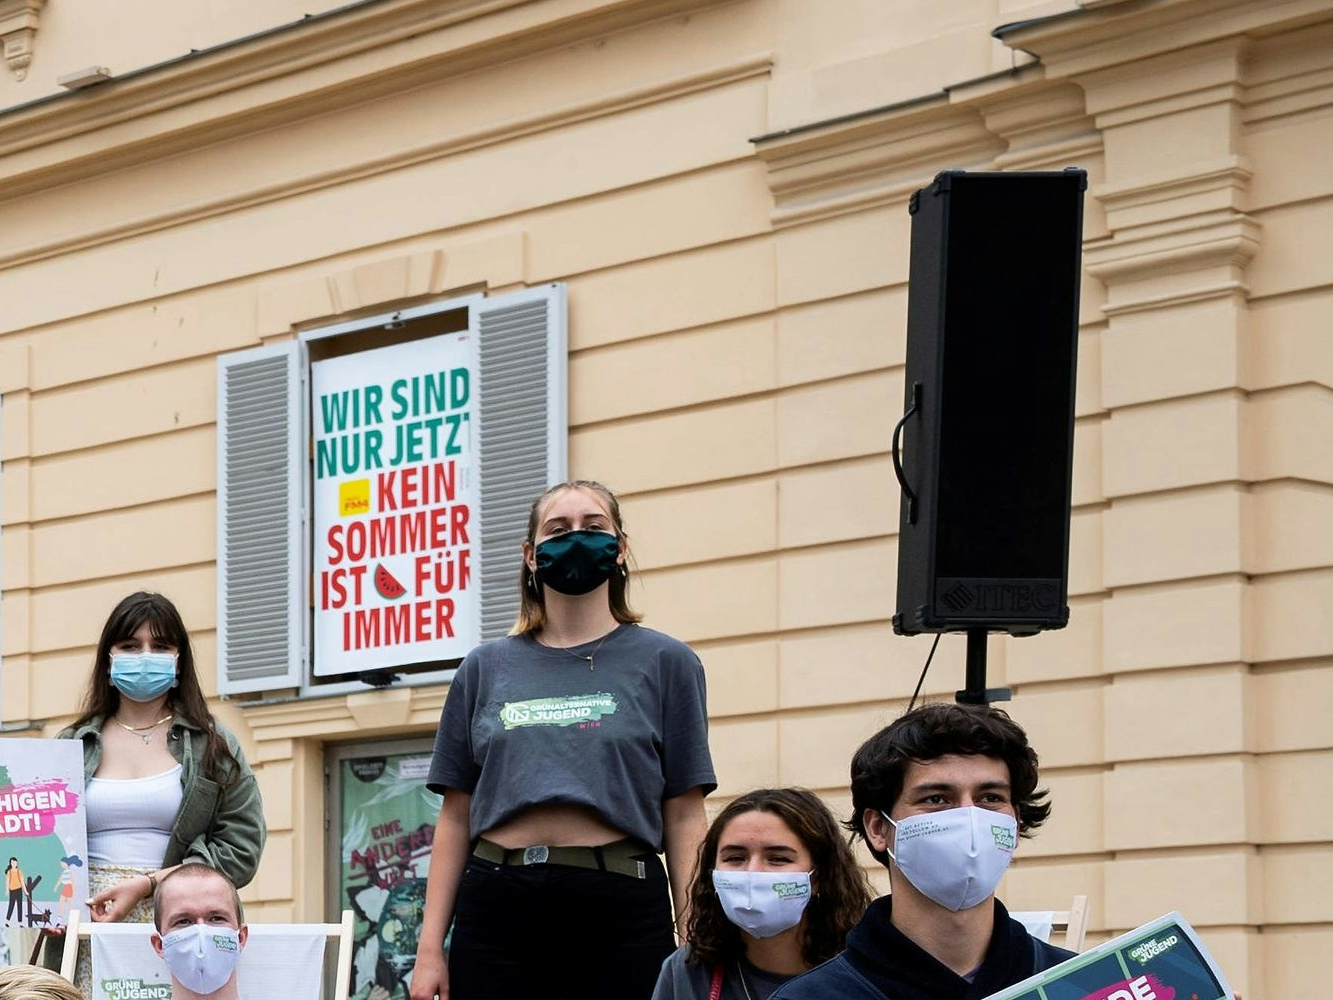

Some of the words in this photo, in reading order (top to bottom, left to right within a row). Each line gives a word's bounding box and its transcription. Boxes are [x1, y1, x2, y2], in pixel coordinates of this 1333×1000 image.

[321, 384, 383, 434] WIR
[390, 367, 469, 421] SIND
[317, 429, 383, 480] NUR
[377, 460, 456, 513] KEIN
[327, 504, 470, 566] SOMMER
[321, 565, 367, 610] IST
[974, 584, 1057, 612] ITEC
[343, 598, 455, 652] IMMER
[530, 699, 612, 711] GRÜNALTERNATIVE
[533, 707, 591, 720] JUGEND
[1132, 939, 1158, 957] GRÜNE
[1141, 935, 1178, 962] JUGEND
[105, 980, 140, 991] GRÜNE
[113, 988, 167, 1000] JUGEND
